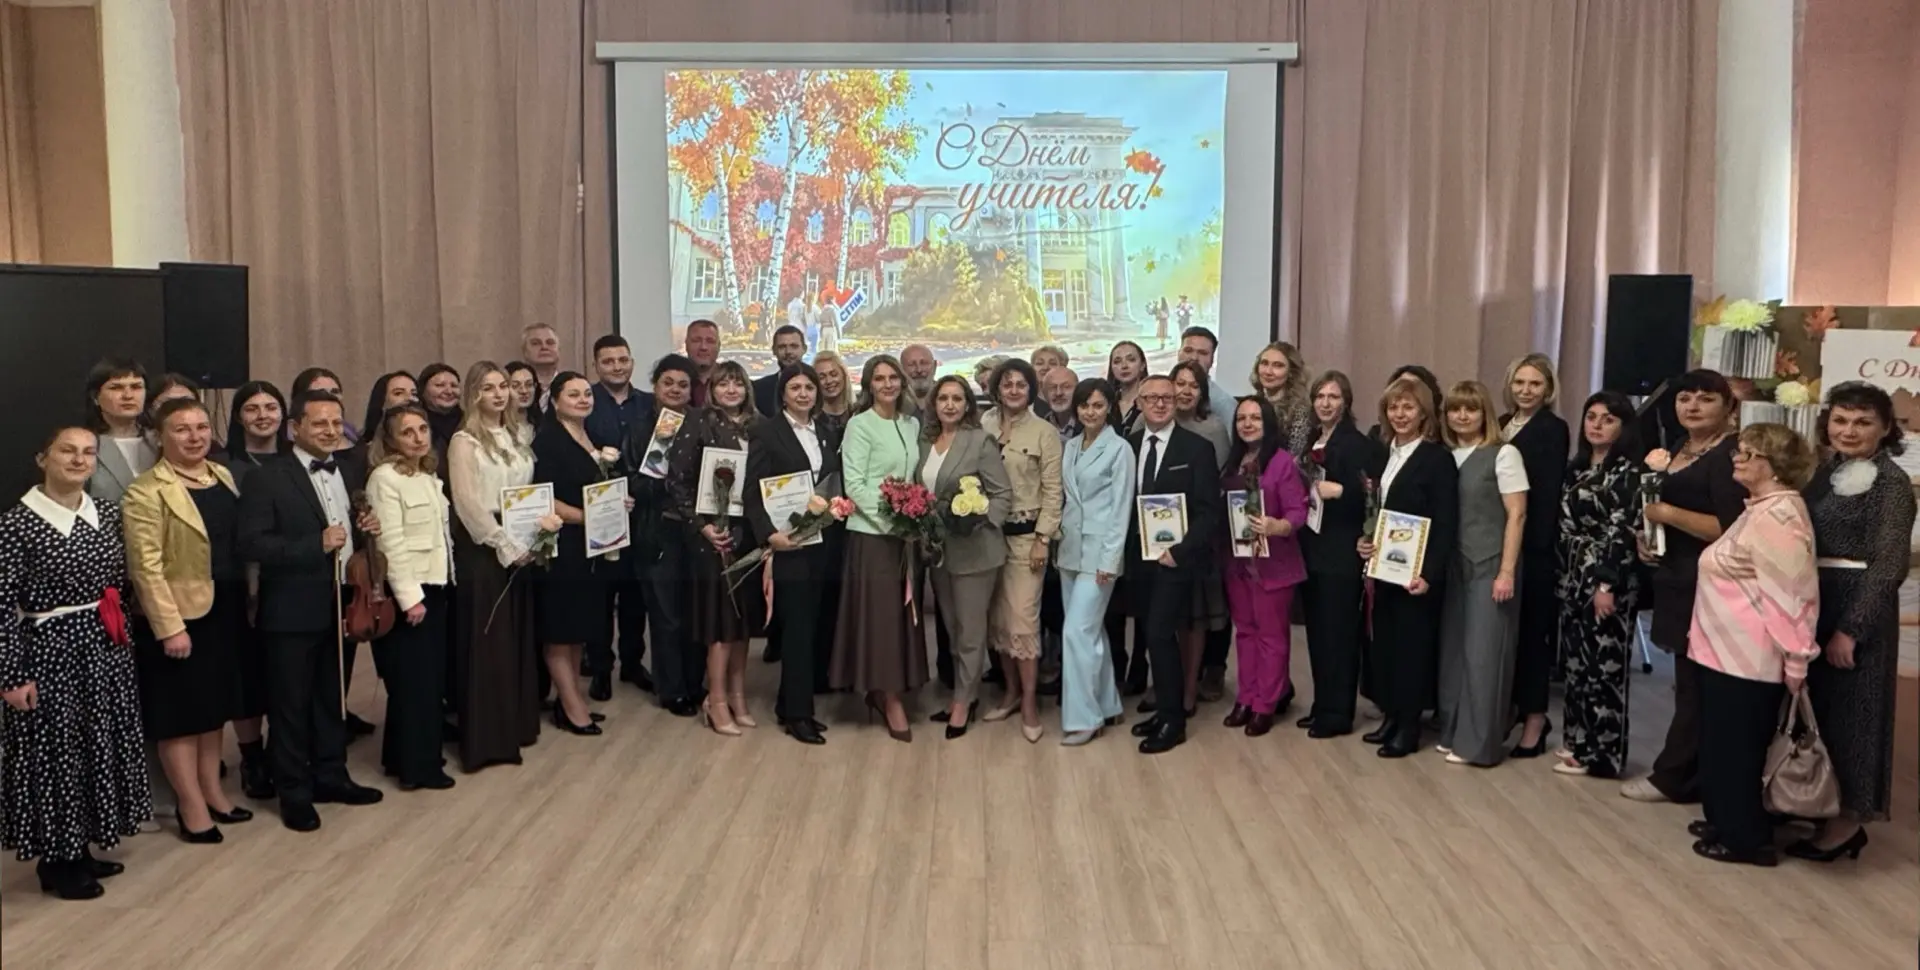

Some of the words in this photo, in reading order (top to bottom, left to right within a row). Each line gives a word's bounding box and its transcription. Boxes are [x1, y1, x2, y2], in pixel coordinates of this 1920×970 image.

[935, 122, 975, 170] С
[978, 124, 1091, 168] Днём
[950, 164, 1167, 231] учителя!
[1858, 358, 1880, 378] С
